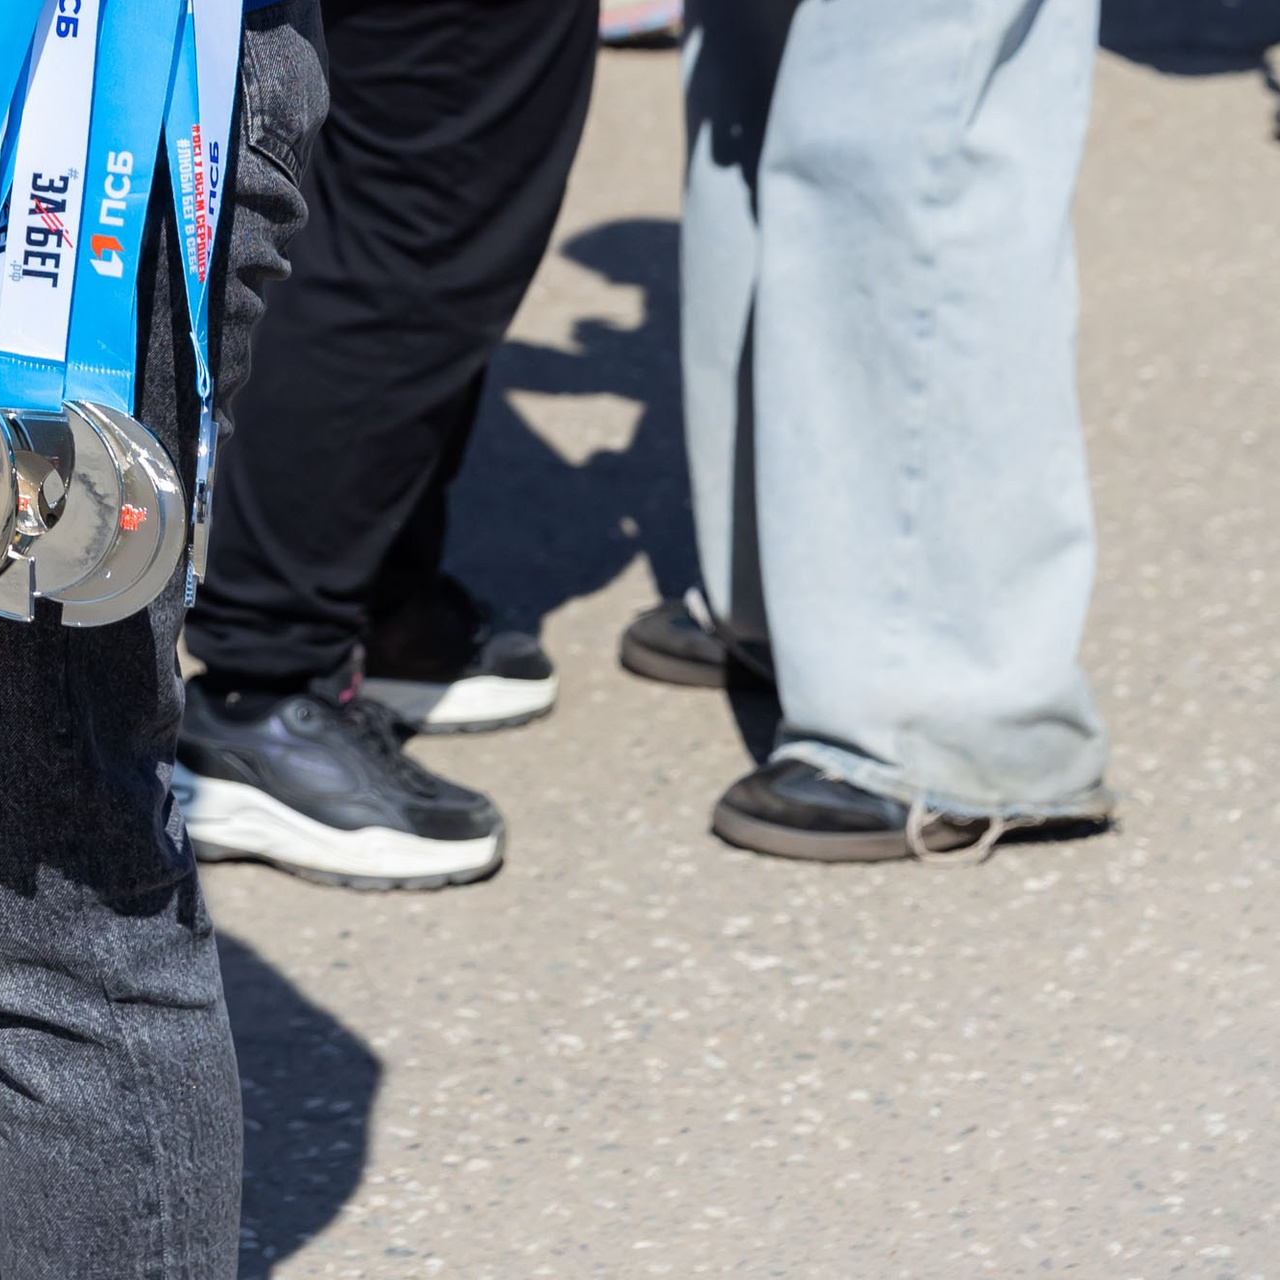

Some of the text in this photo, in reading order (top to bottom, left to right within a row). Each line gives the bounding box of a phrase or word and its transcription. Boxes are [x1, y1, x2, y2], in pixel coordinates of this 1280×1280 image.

[99, 150, 133, 227] ПСБ
[176, 138, 193, 193] #ЛЮБИ
[208, 140, 220, 216] ПСБ
[182, 194, 195, 221] БЕГ
[186, 236, 198, 275] СЕБЕ
